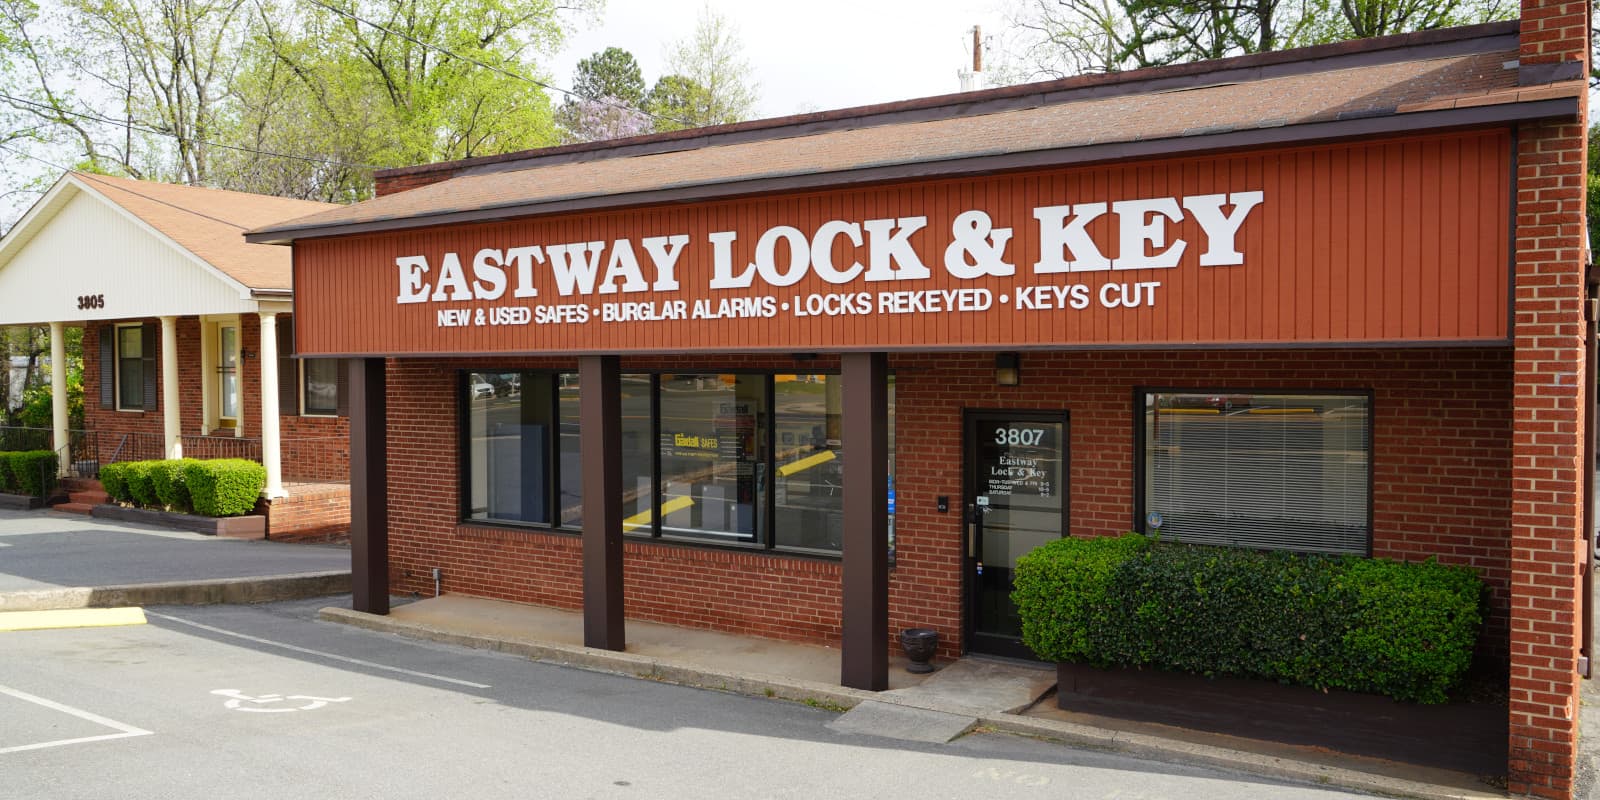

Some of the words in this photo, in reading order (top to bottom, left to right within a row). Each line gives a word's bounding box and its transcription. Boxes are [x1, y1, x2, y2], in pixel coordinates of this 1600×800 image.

[395, 233, 691, 305] EASTWAY
[708, 215, 931, 290] LOCK
[944, 209, 1016, 280] &
[1033, 190, 1264, 275] KEY
[78, 294, 104, 310] 3805
[437, 307, 472, 328] NEW
[473, 307, 487, 327] &
[488, 305, 532, 327] USED
[534, 303, 590, 325] SAFES
[601, 299, 688, 323] BURGLAR
[690, 294, 778, 321] ALARMS
[793, 290, 873, 317] LOCKS
[877, 287, 993, 315] REKEYED
[1015, 283, 1091, 311] KEYS
[1098, 281, 1162, 309] CUT
[995, 428, 1044, 446] 3807
[999, 456, 1038, 467] Eastway
[991, 466, 1013, 476] Lock
[1016, 468, 1025, 477] &
[1030, 468, 1046, 479] Key
